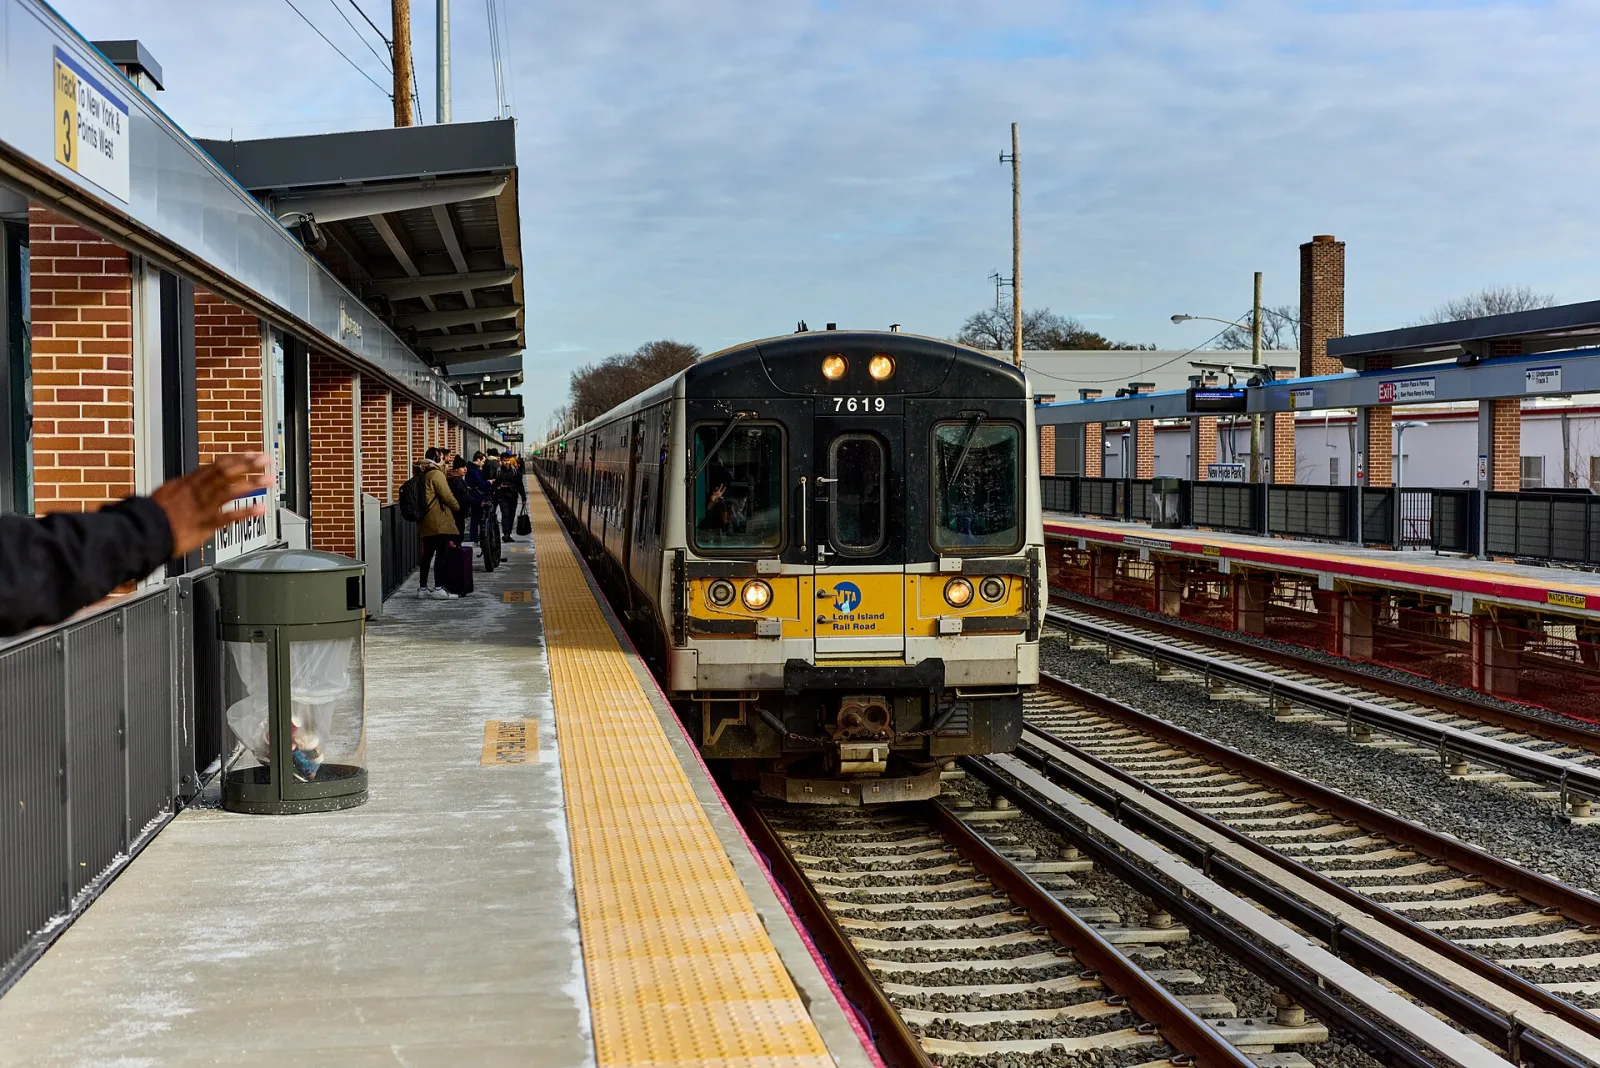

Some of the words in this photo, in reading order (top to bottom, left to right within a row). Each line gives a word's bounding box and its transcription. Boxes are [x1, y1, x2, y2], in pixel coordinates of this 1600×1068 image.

[56, 63, 76, 102] Track
[77, 79, 85, 109] To
[87, 87, 100, 121] New
[101, 97, 115, 135] York
[116, 112, 120, 136] &
[63, 109, 71, 163] 3
[77, 111, 98, 150] Points
[99, 126, 114, 161] West
[1380, 384, 1392, 398] Exit
[833, 398, 886, 412] 7619
[1208, 466, 1217, 478] New
[1219, 466, 1230, 481] Hyde
[1231, 466, 1241, 478] Park
[833, 588, 857, 606] MTA
[1548, 593, 1564, 602] WATCH
[1565, 594, 1574, 603] THE
[1575, 596, 1584, 604] GAP
[833, 613, 855, 621] Long
[857, 612, 885, 620] Island
[853, 622, 876, 630] Road
